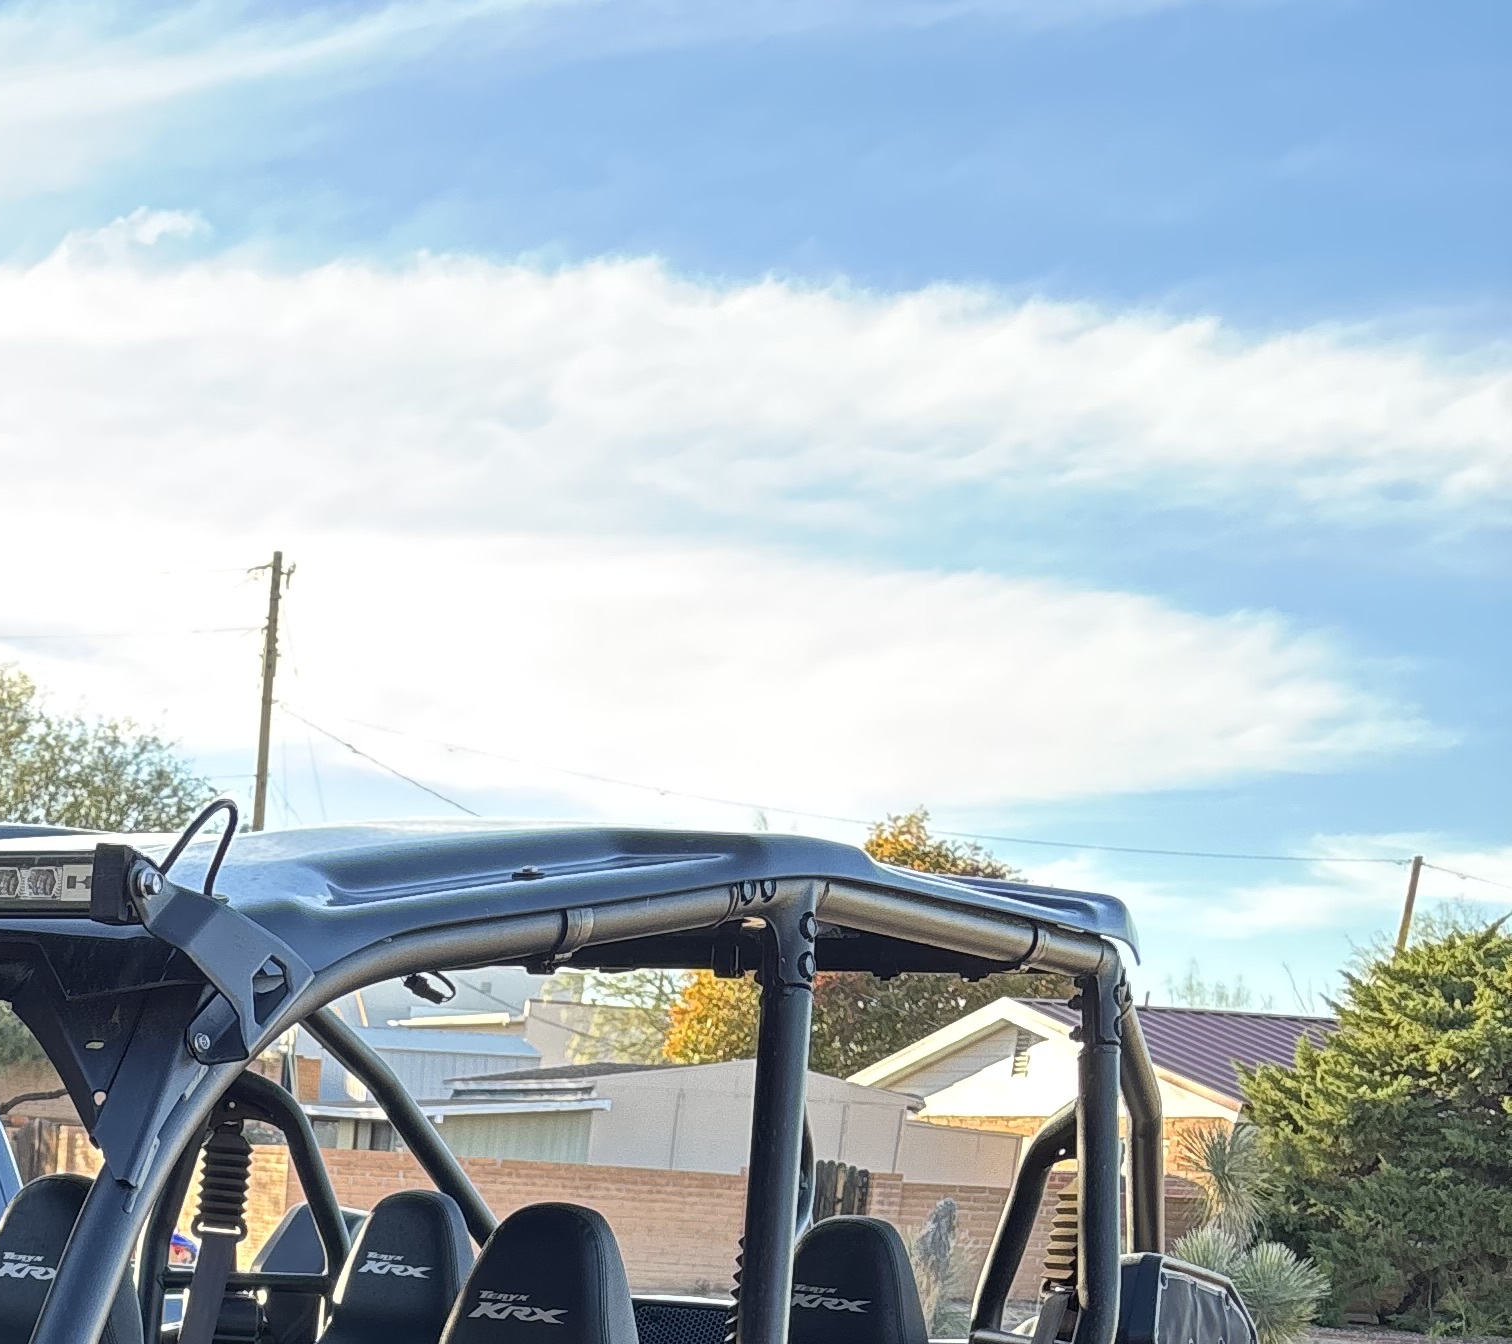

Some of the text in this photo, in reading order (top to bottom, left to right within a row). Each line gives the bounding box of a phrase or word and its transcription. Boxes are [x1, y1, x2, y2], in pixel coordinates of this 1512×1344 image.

[357, 1260, 433, 1279] KRX
[468, 1301, 568, 1325] KRX
[791, 1293, 871, 1313] KRX
